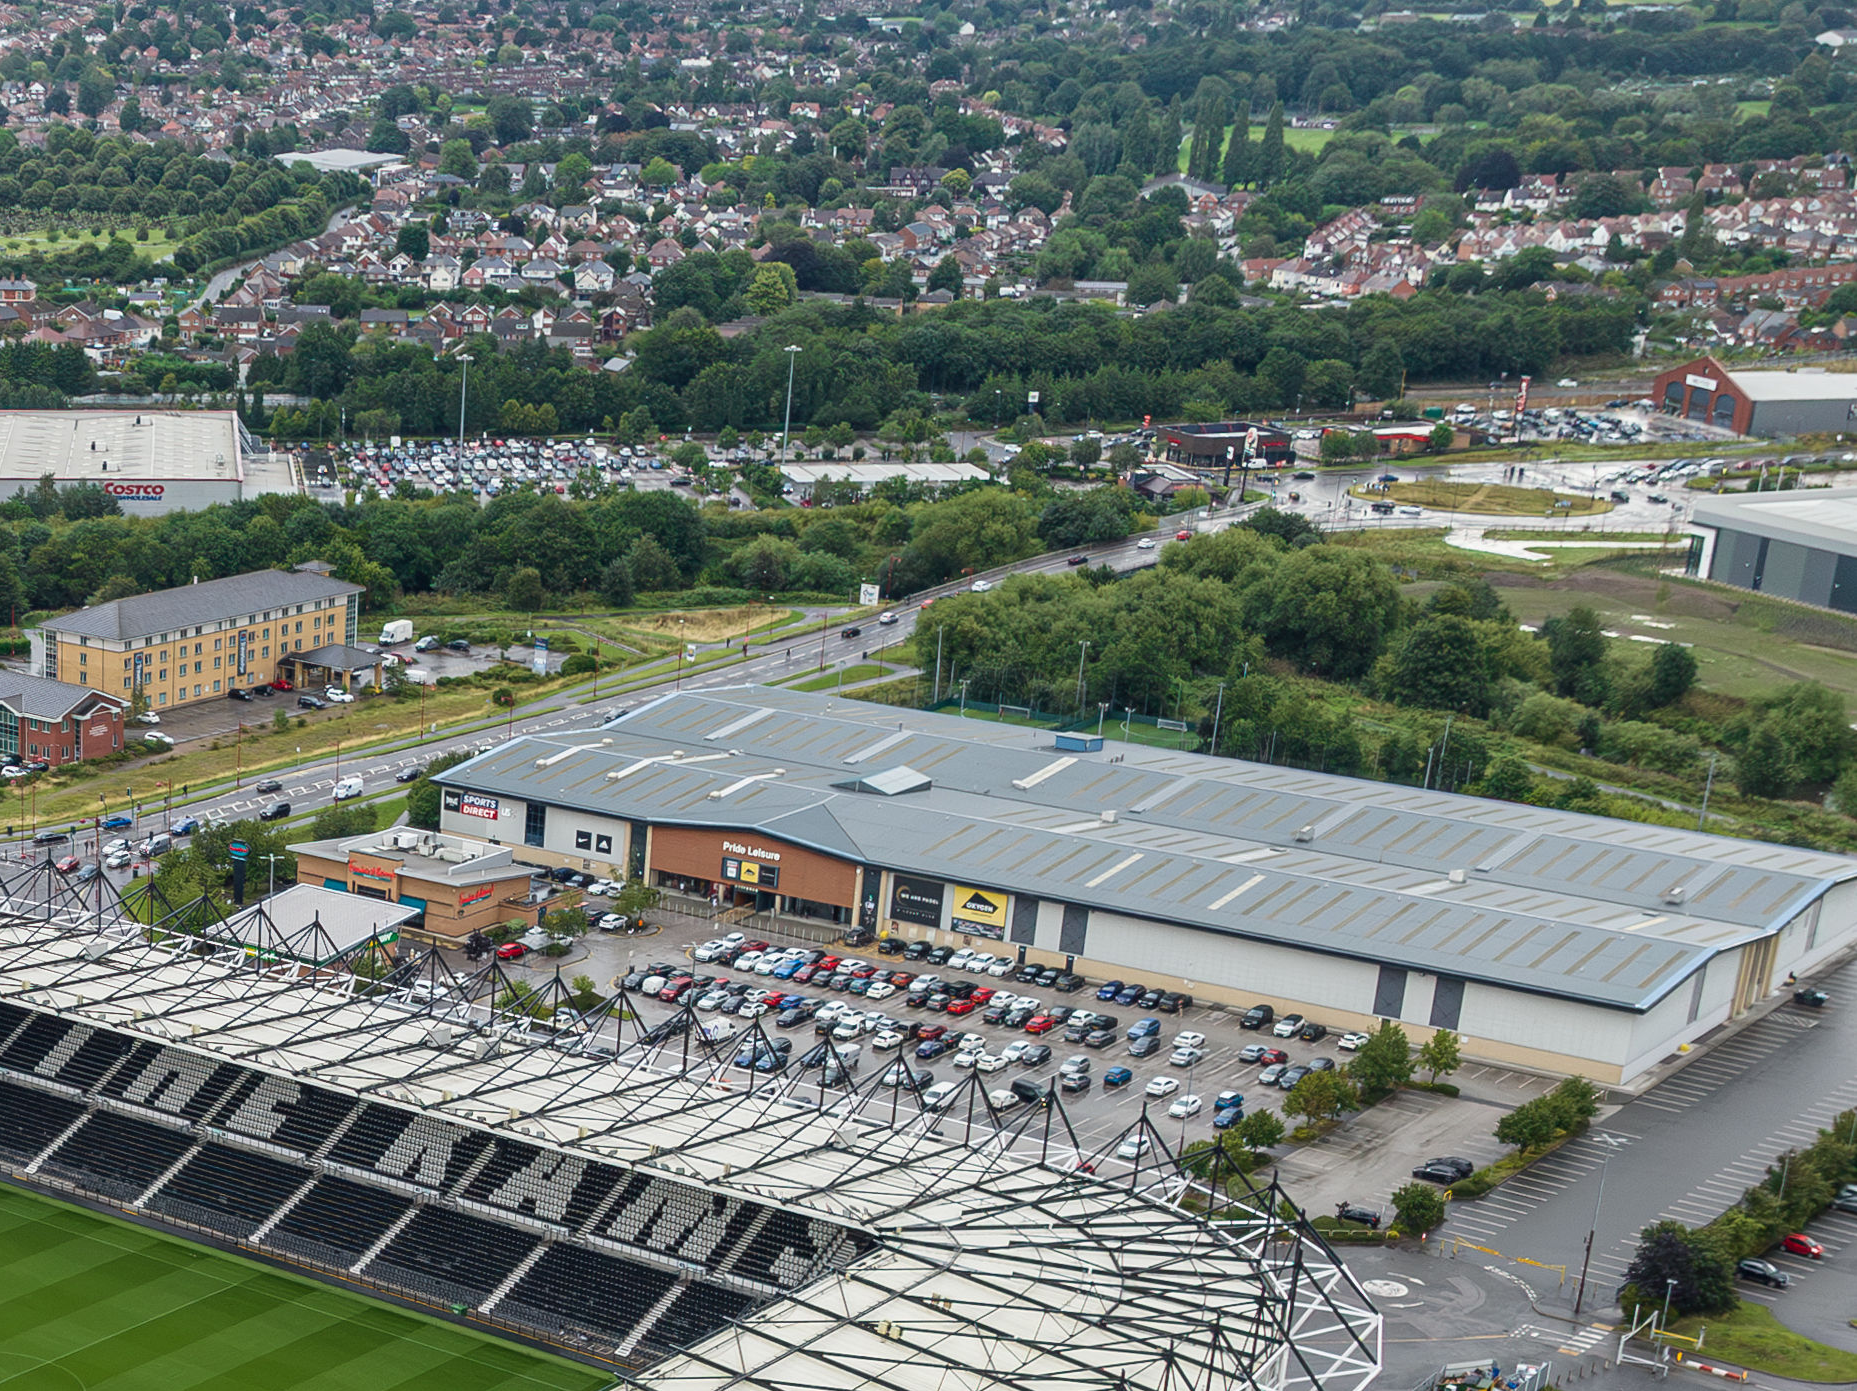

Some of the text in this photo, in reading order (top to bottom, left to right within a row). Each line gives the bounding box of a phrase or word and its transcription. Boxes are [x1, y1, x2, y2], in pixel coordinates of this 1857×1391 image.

[104, 482, 164, 494] COSTCO
[463, 794, 496, 809] SPORTS
[462, 805, 495, 819] DIRECT
[723, 841, 780, 861] Pride Leisure
[966, 901, 994, 912] OXYGEN
